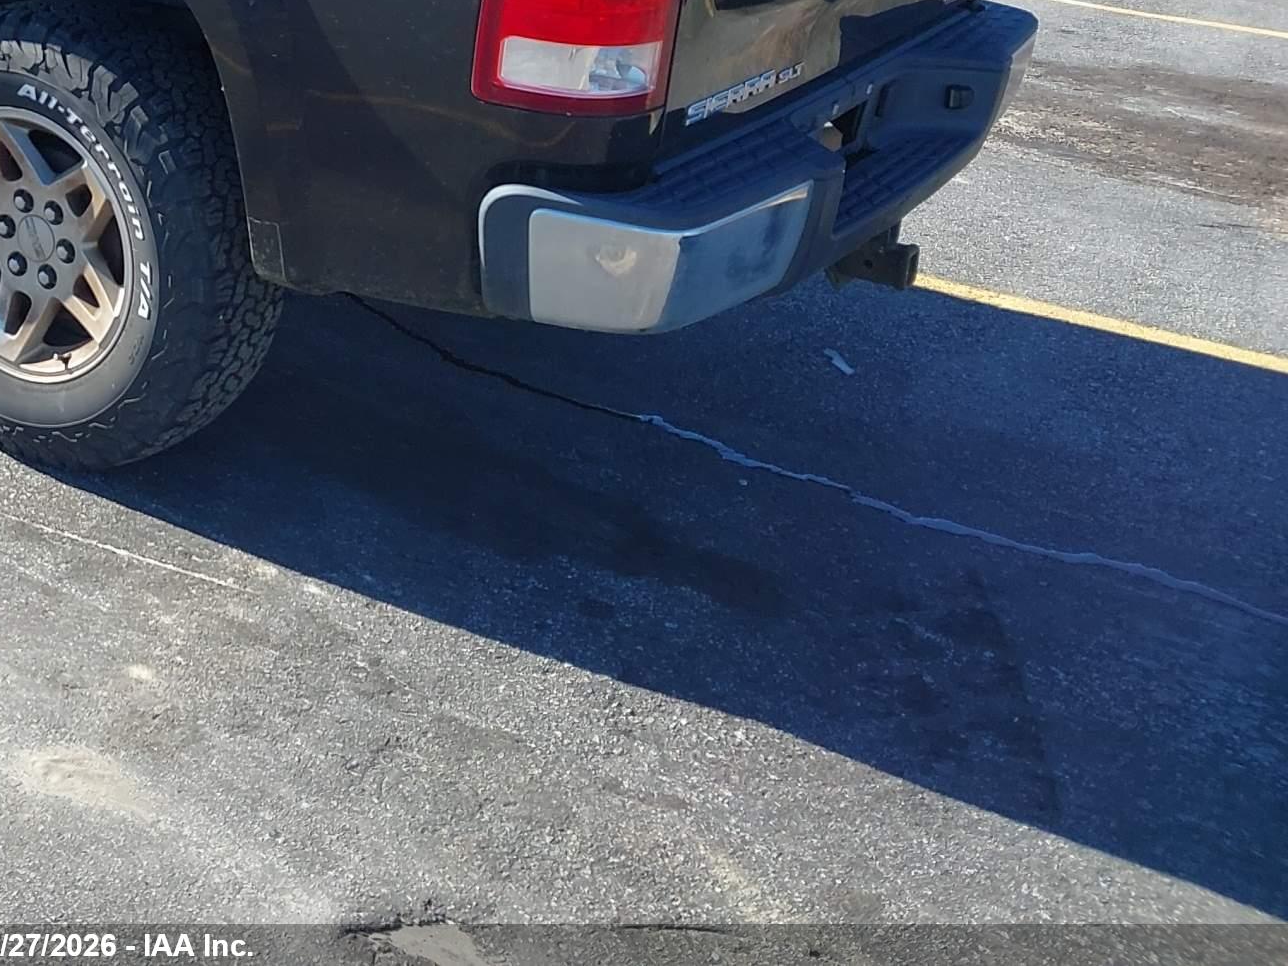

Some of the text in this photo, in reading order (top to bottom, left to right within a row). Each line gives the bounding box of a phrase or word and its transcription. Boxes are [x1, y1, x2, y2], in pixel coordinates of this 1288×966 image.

[685, 61, 806, 126] SIERRA SLT
[17, 83, 153, 320] All-Terrain T/A
